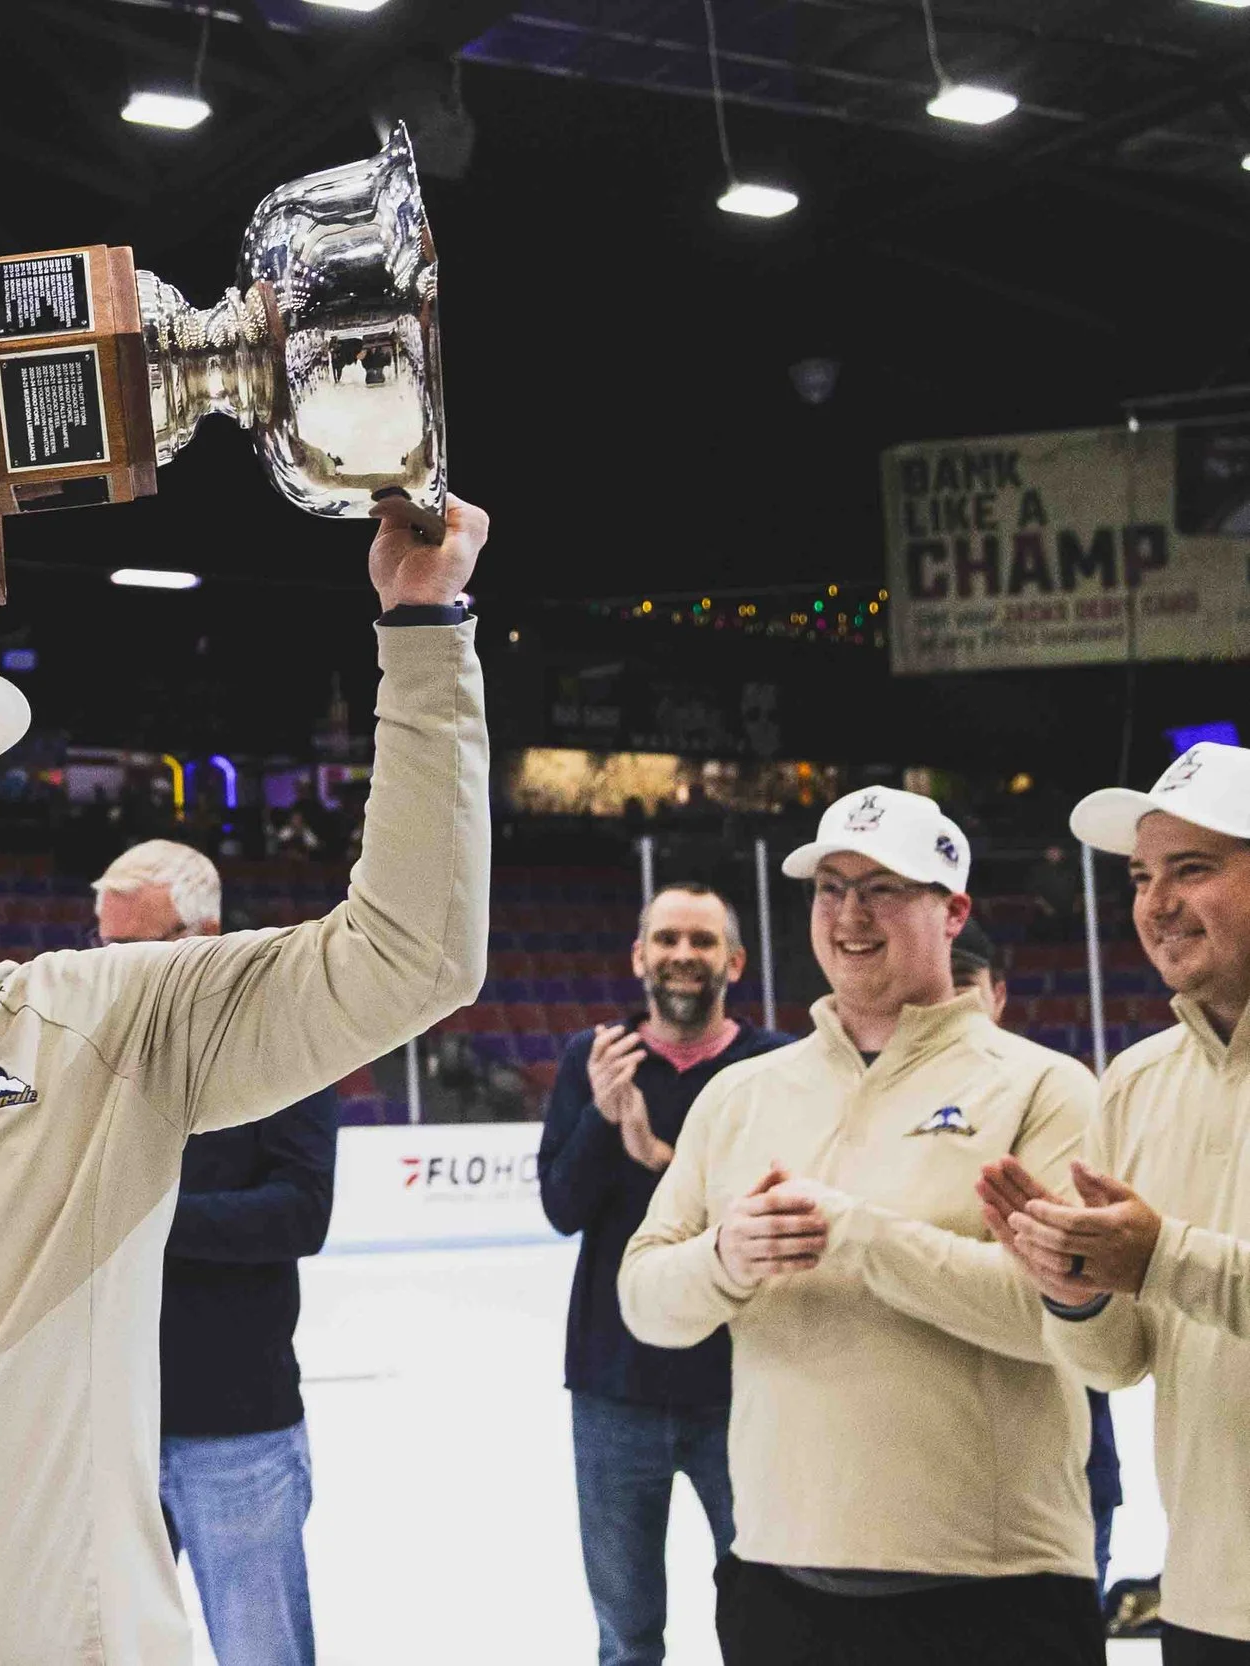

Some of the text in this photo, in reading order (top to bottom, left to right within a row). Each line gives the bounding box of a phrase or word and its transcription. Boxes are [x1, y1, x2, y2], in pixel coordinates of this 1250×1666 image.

[22, 388, 32, 420] MUSKEGON
[37, 386, 47, 426] YOUNGSTOWN
[50, 385, 58, 410] CHICAGO
[63, 383, 71, 402] FARGO
[70, 382, 78, 408] CHICAGO
[76, 382, 84, 404] TRI-CITY
[32, 406, 40, 425] FORCE
[65, 403, 73, 422] FORCE
[25, 420, 36, 461] LUMBERJACKS
[41, 426, 50, 456] PHANTOMS
[46, 416, 56, 453] MUSKETEERS
[60, 419, 69, 448] STAMPEDE
[903, 450, 1021, 493] BANK
[905, 487, 1048, 537] LIKE A
[907, 522, 1170, 598] CHAMP
